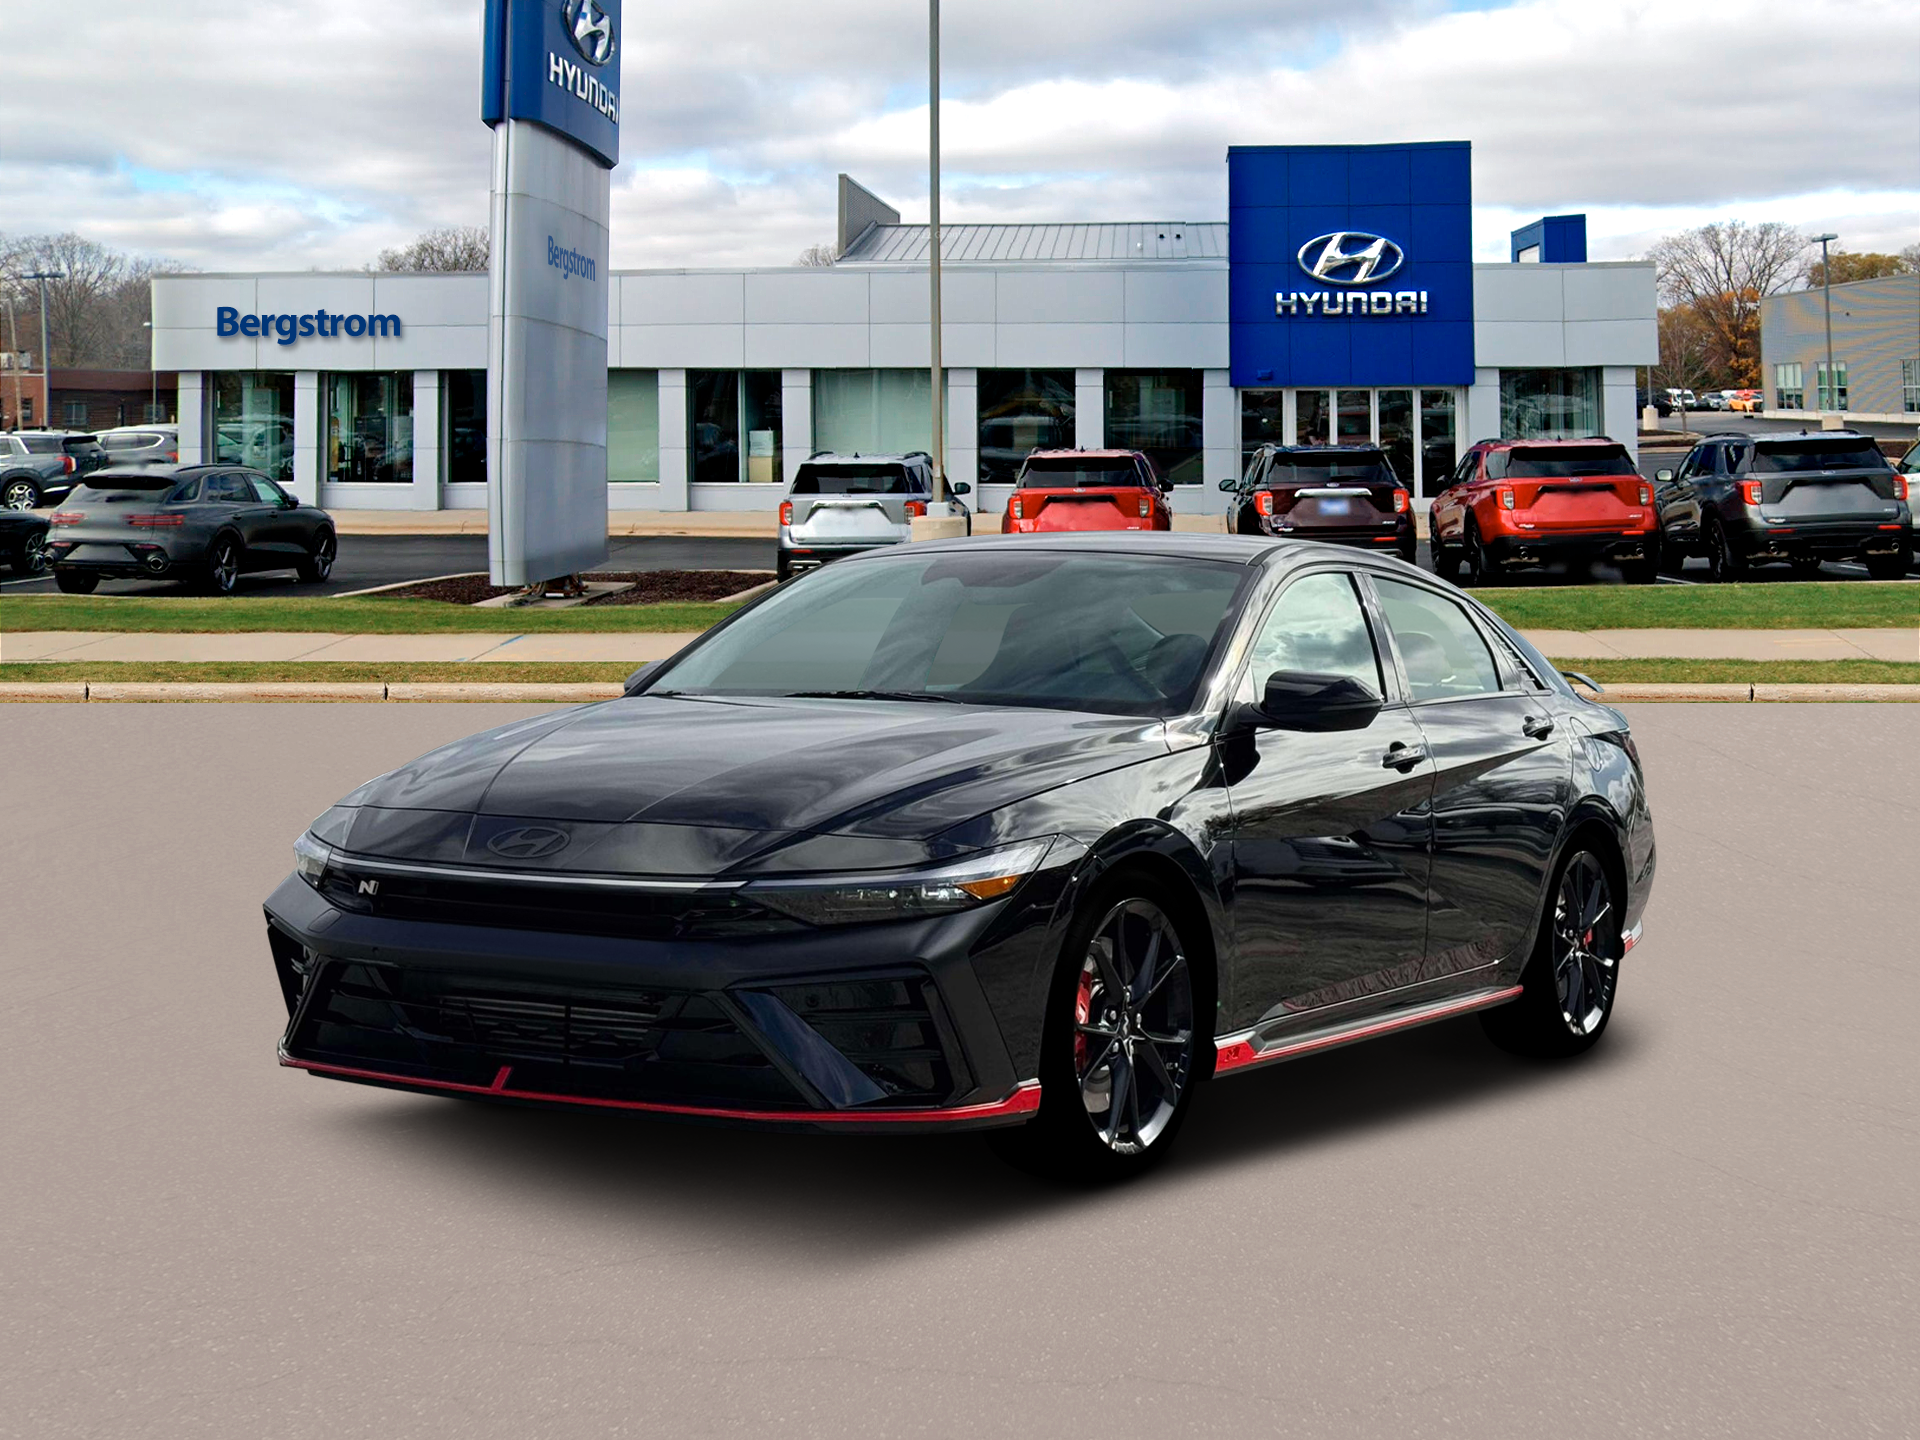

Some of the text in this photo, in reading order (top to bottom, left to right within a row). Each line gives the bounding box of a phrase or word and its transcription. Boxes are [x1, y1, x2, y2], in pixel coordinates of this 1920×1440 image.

[549, 52, 618, 124] HYUNDAI
[548, 235, 596, 282] Bergstrom
[1276, 291, 1428, 315] HYUNDAI
[217, 306, 402, 346] Bergstrom
